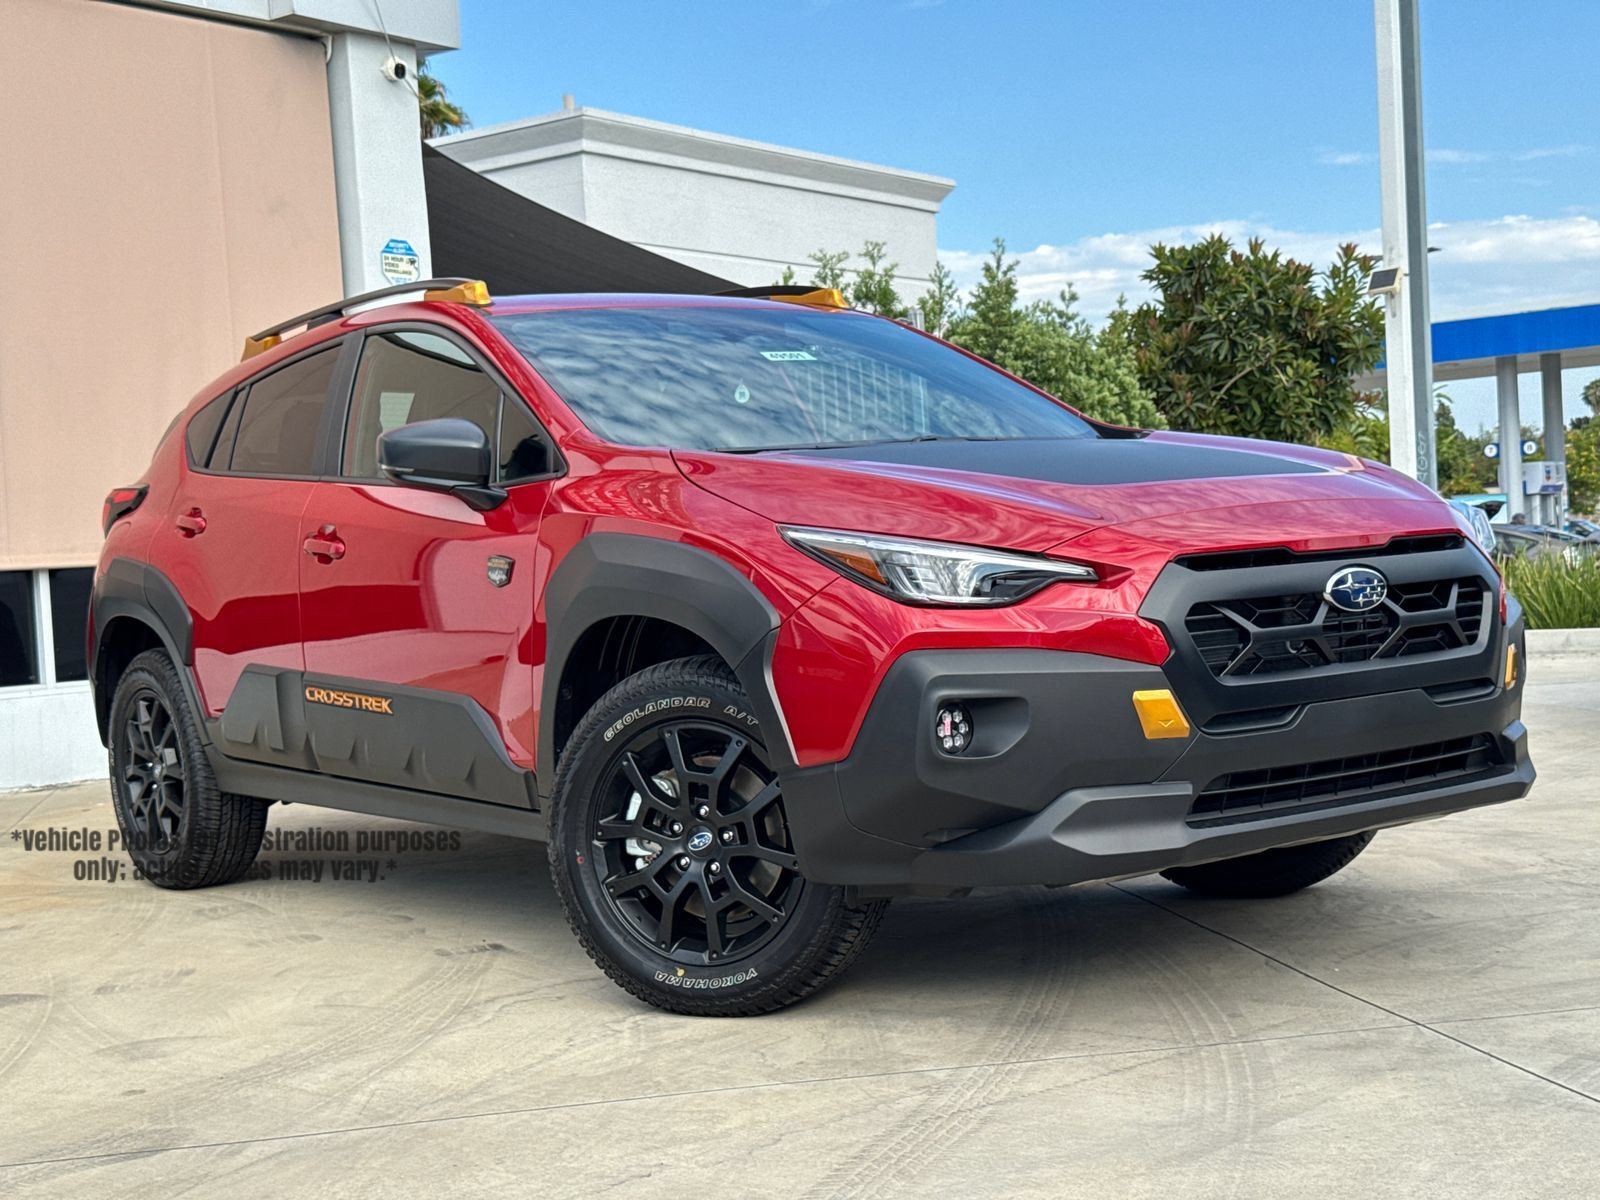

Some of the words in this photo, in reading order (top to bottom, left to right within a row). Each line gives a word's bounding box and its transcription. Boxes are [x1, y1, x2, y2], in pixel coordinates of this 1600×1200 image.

[305, 687, 393, 714] CROSSTREK
[603, 696, 711, 742] GEOLANDAR
[723, 705, 759, 726] A/T
[654, 968, 758, 989] YOKOHAMA
